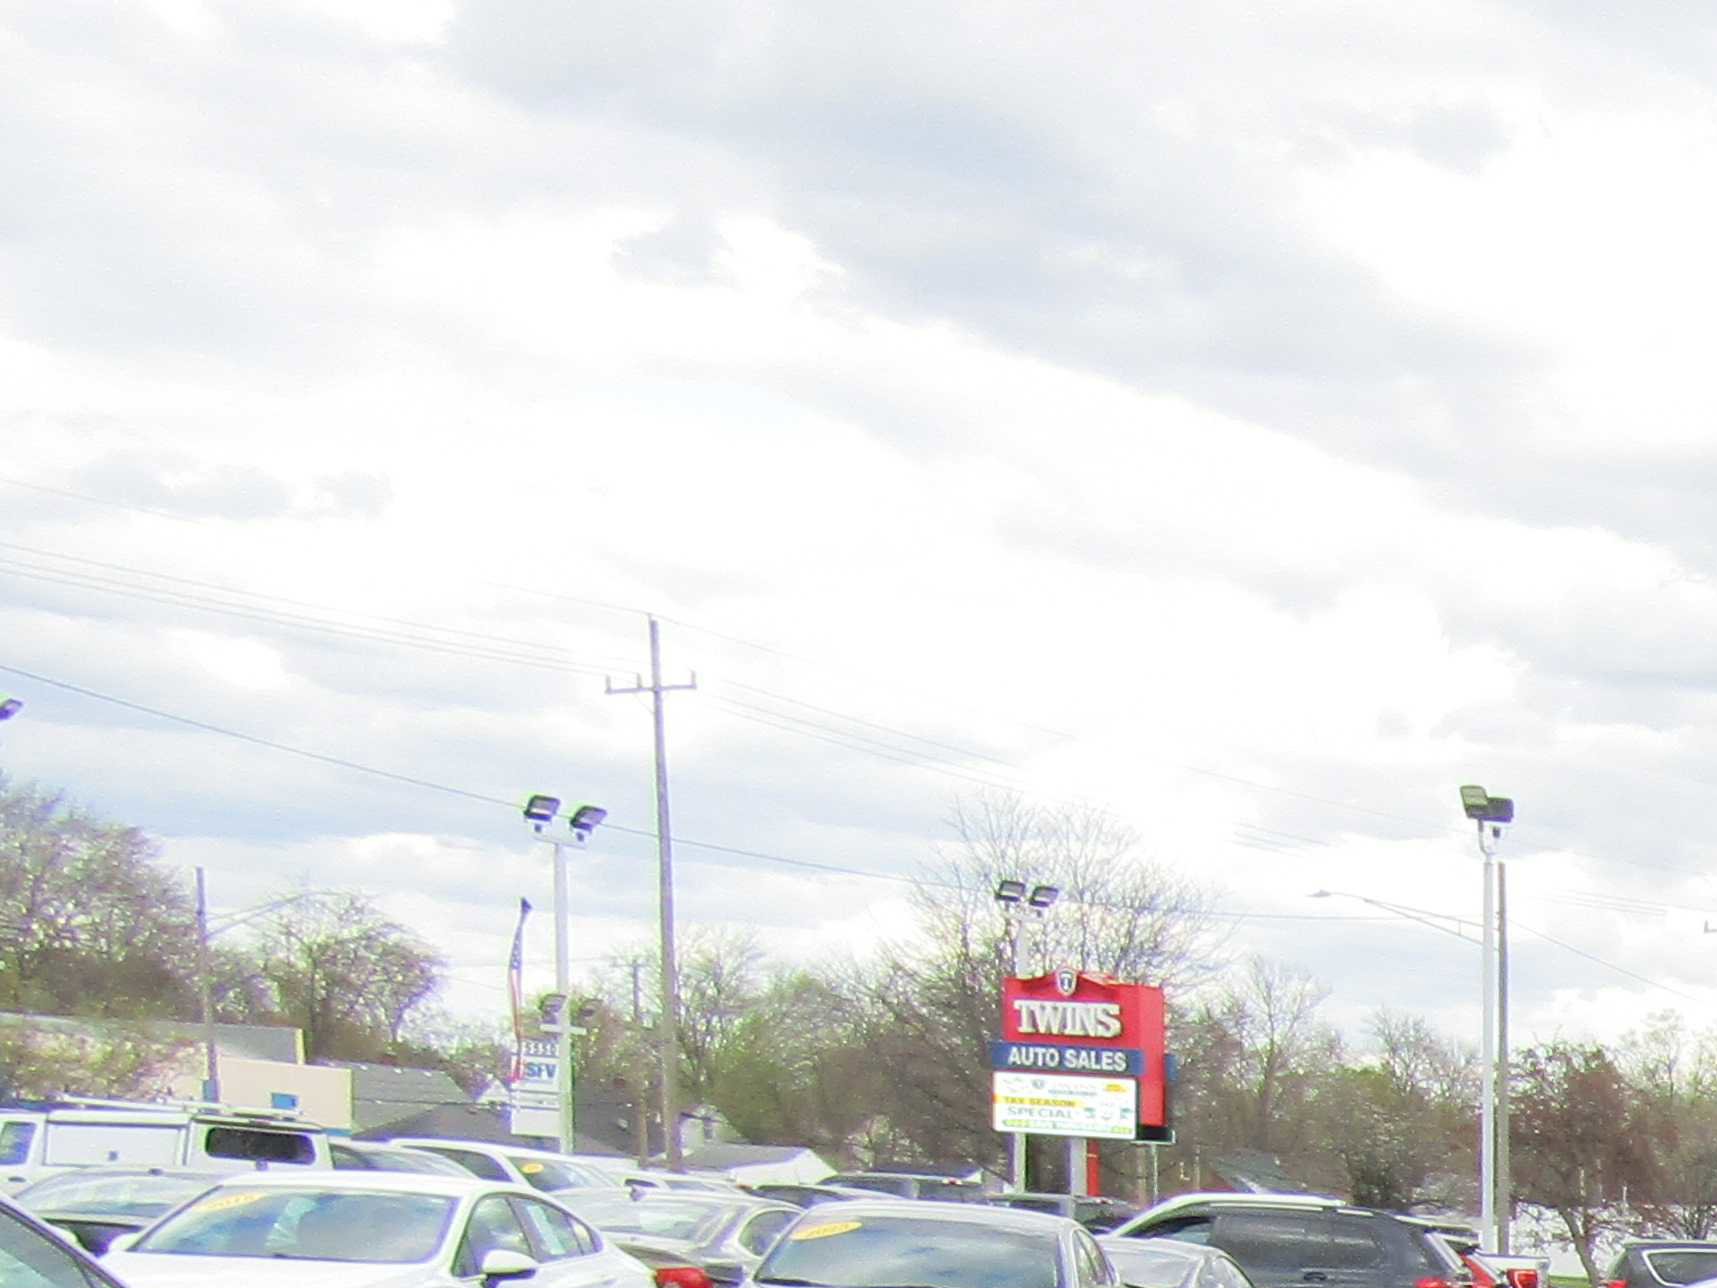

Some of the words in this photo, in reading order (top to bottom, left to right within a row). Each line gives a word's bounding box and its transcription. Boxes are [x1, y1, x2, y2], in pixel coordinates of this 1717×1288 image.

[1013, 999, 1122, 1037] TWINS
[1007, 1046, 1060, 1067] AUTO
[1063, 1049, 1128, 1072] SALES
[1007, 1105, 1074, 1119] SPECIAL
